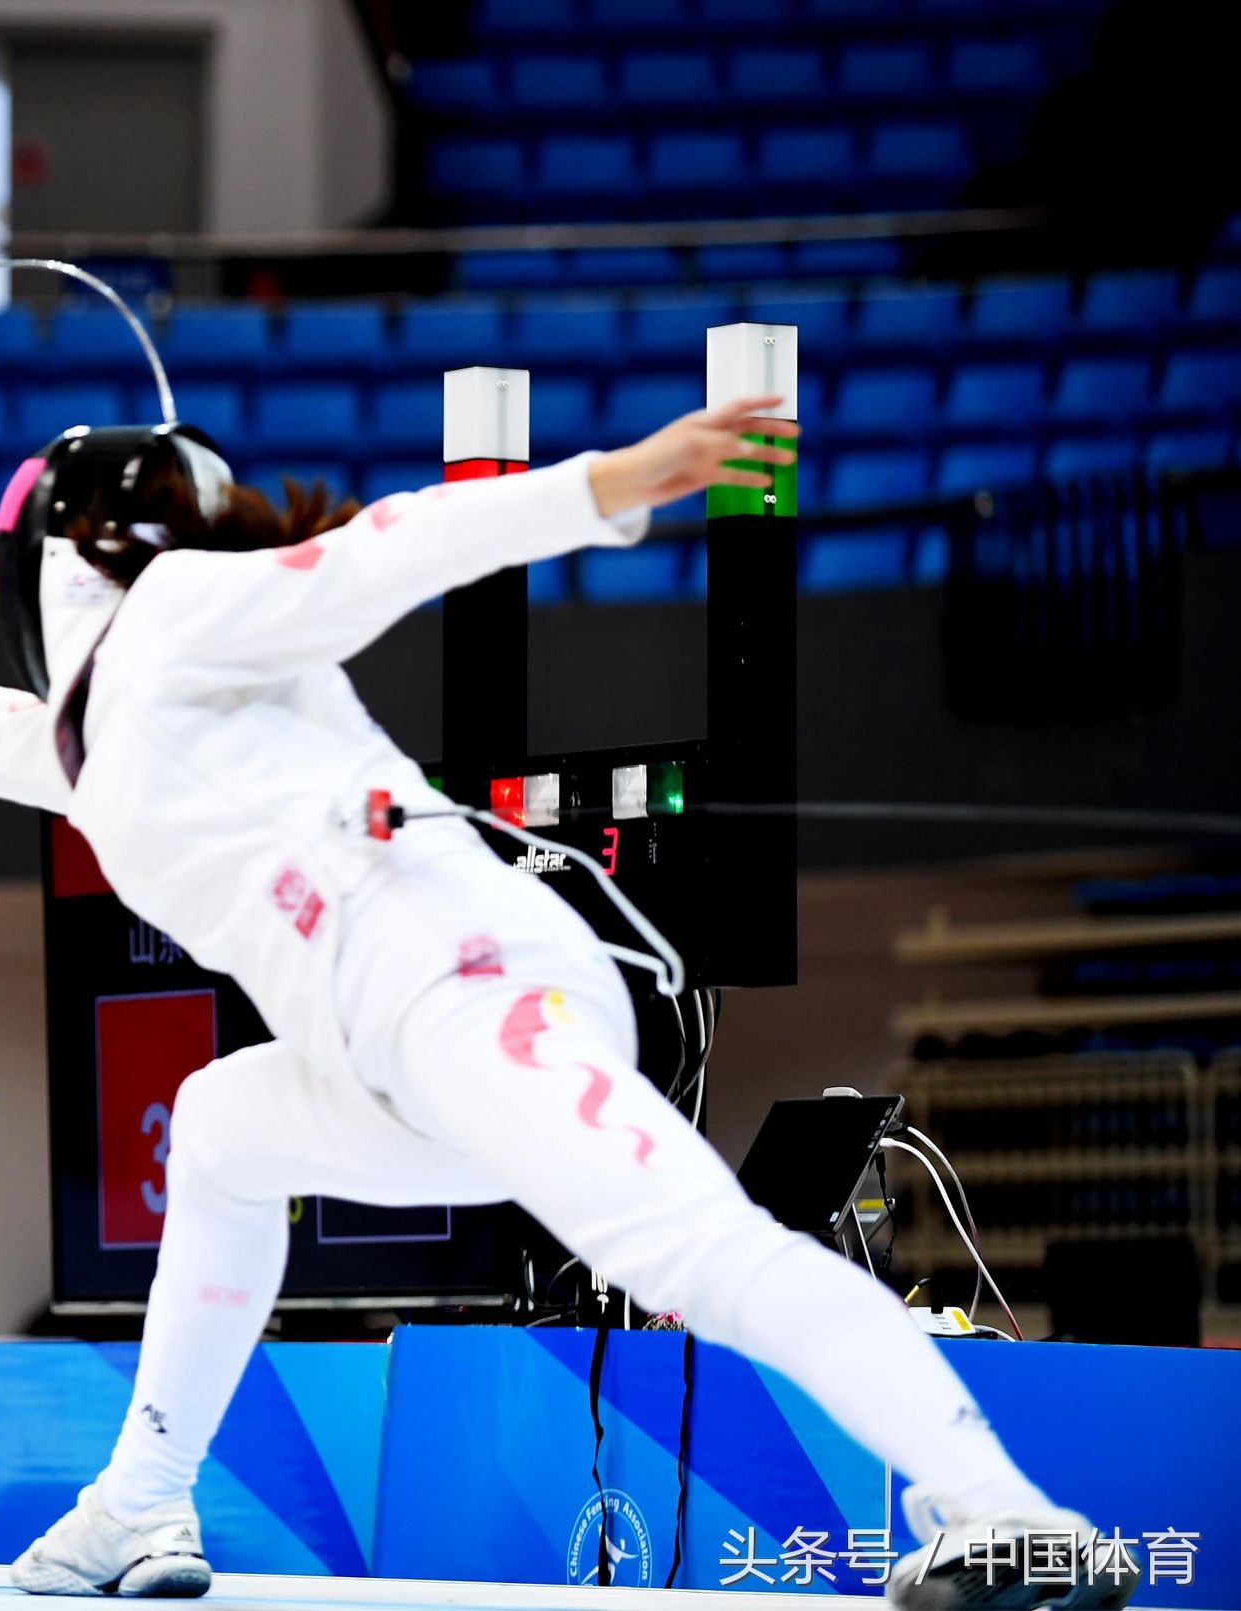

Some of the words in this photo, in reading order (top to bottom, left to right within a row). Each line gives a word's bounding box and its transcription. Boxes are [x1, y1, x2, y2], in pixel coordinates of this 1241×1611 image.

[515, 845, 568, 874] allstar
[600, 827, 620, 876] 3
[569, 1518, 588, 1578] Chinese
[622, 1501, 650, 1581] Association
